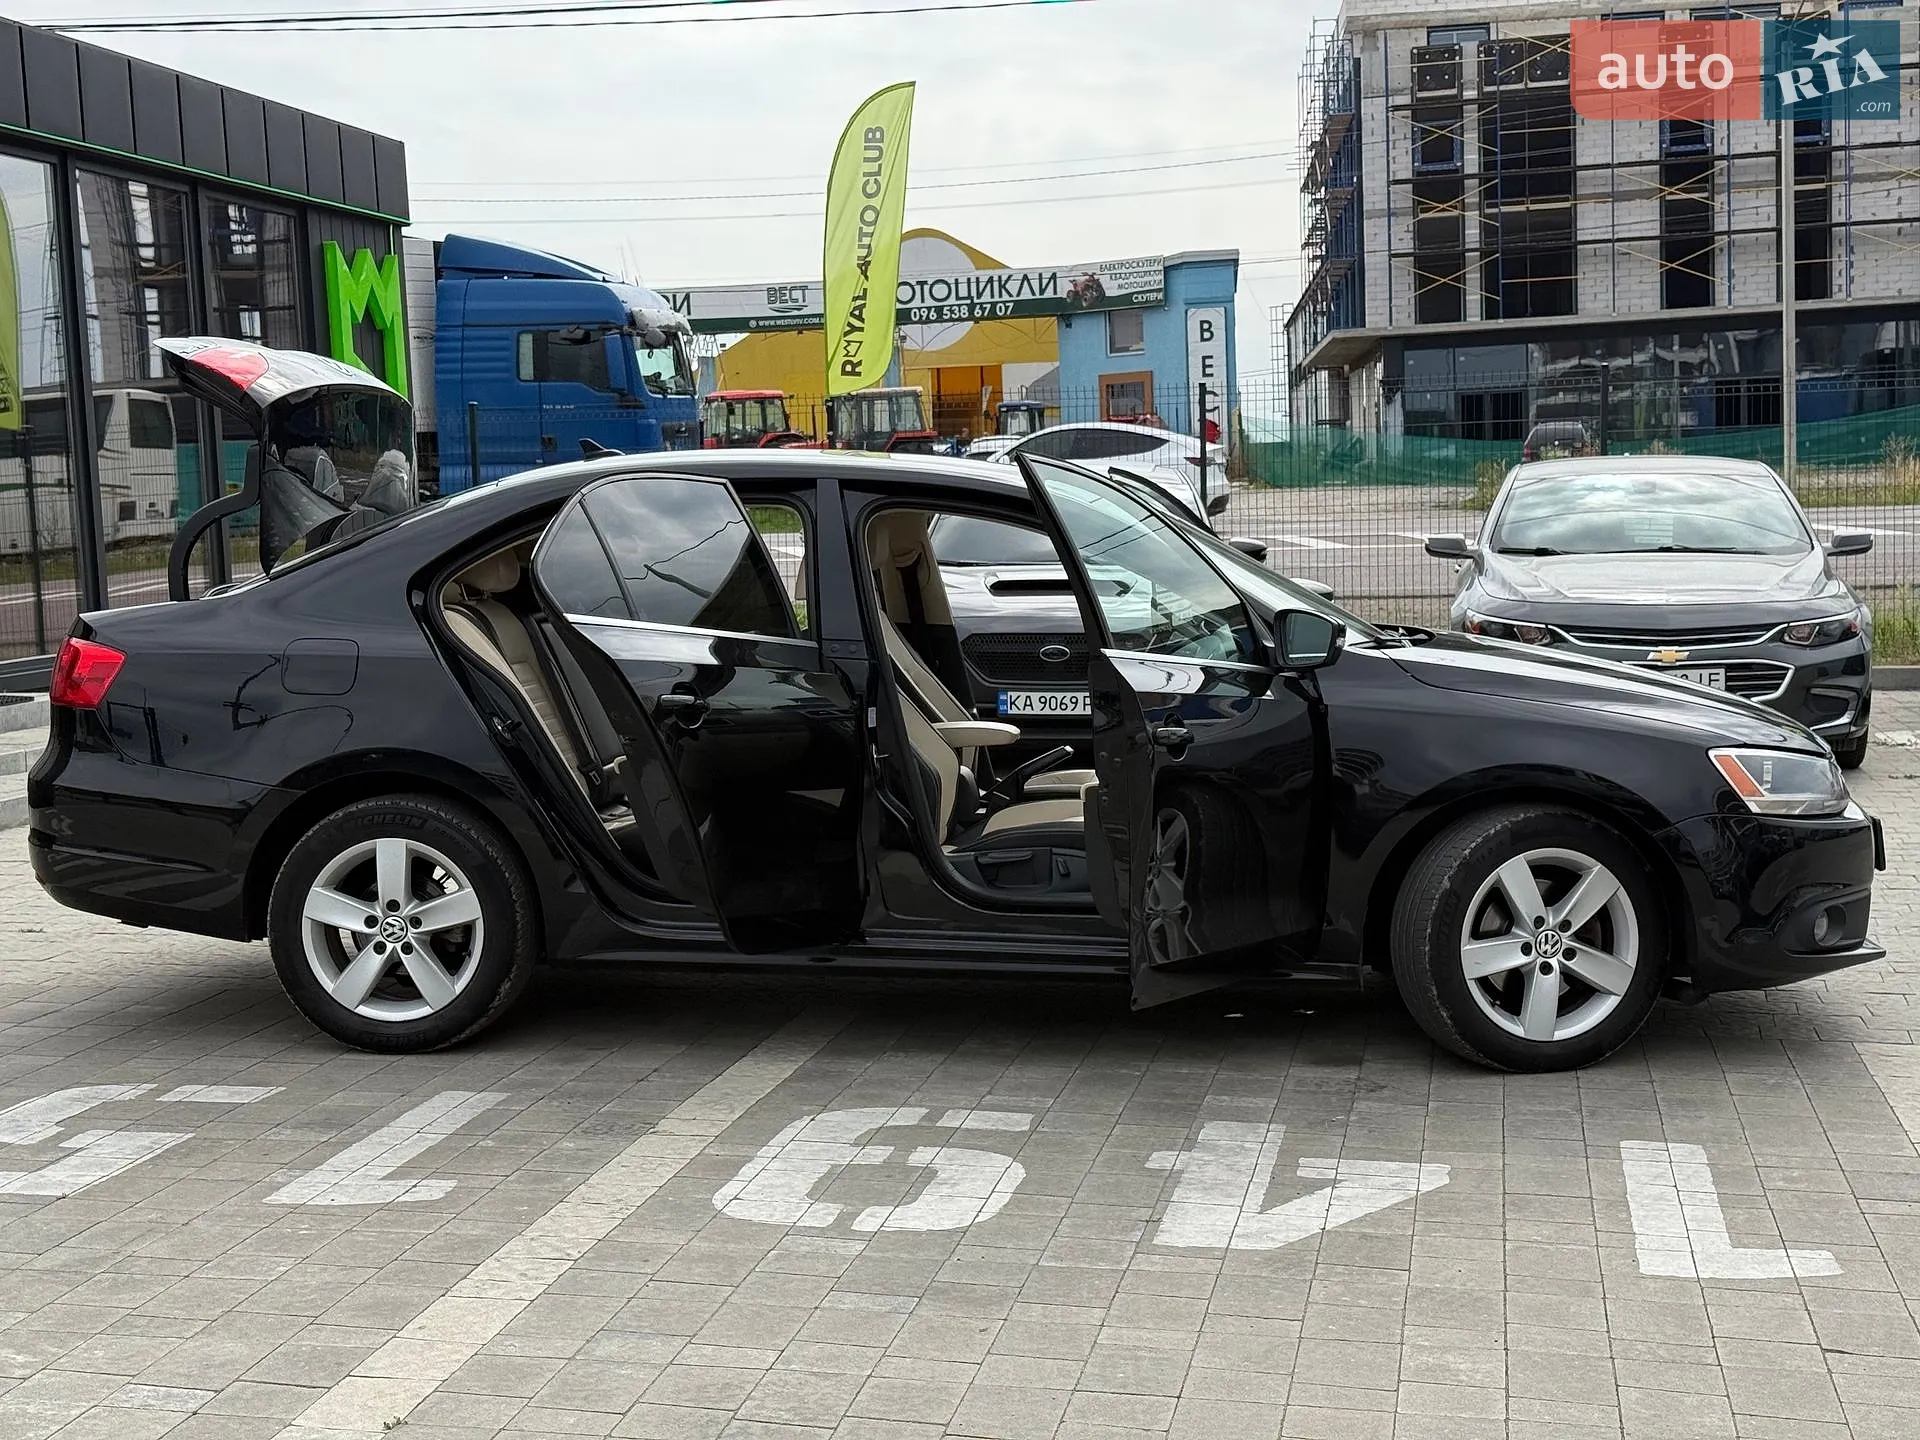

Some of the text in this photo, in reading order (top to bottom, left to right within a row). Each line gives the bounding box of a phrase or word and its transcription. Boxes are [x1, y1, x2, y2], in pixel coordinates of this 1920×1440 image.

[861, 125, 885, 199] CLUB
[856, 205, 880, 282] AUTO
[766, 285, 809, 304] ВЕСТ
[896, 272, 1058, 305] ОТОЦИКЛИ
[1131, 292, 1163, 303] СКУТЕРИ
[911, 302, 1015, 321] 096 538 67 07
[1009, 695, 1034, 711] KA
[1038, 695, 1079, 712] 9069
